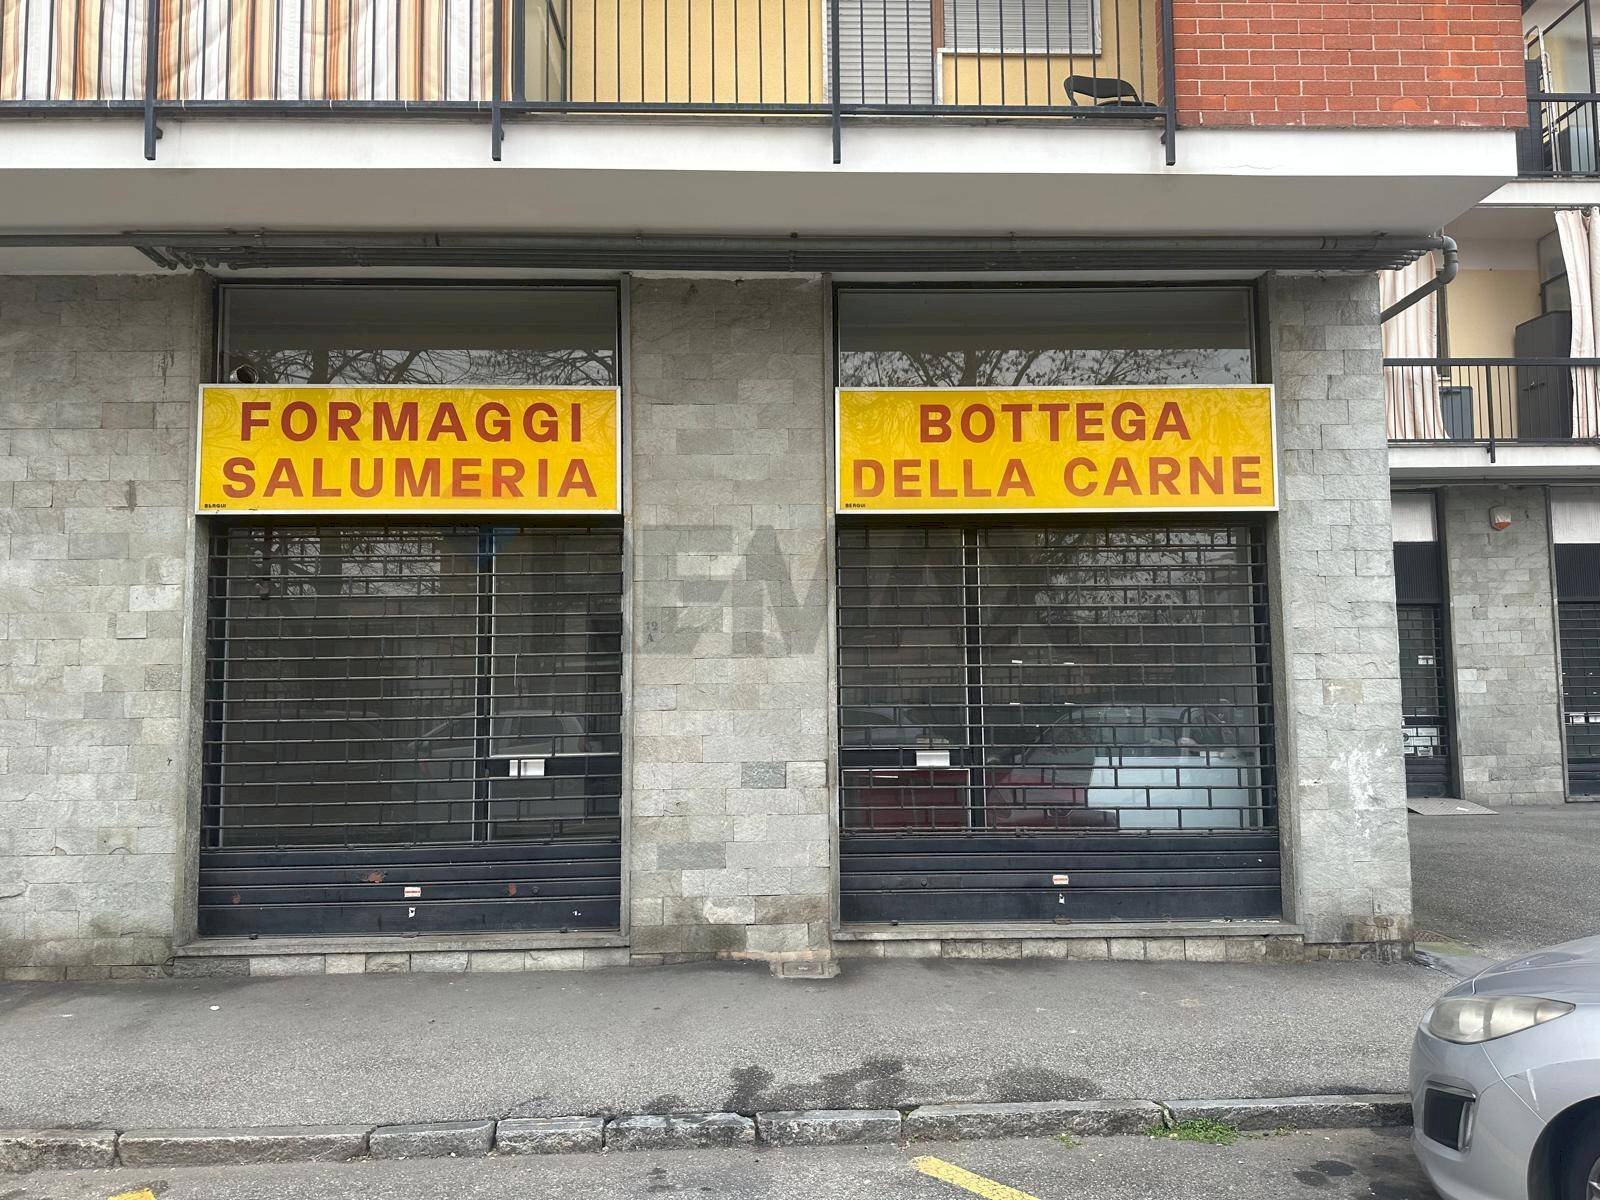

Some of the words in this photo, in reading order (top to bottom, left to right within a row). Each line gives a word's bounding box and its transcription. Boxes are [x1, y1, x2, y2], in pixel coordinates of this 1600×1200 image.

[241, 401, 581, 442] FORMAGGI
[920, 402, 1190, 443] BOTTEGA
[223, 457, 596, 498] SALUMERIA
[854, 459, 1034, 497] DELLA
[1064, 456, 1261, 496] CARNE
